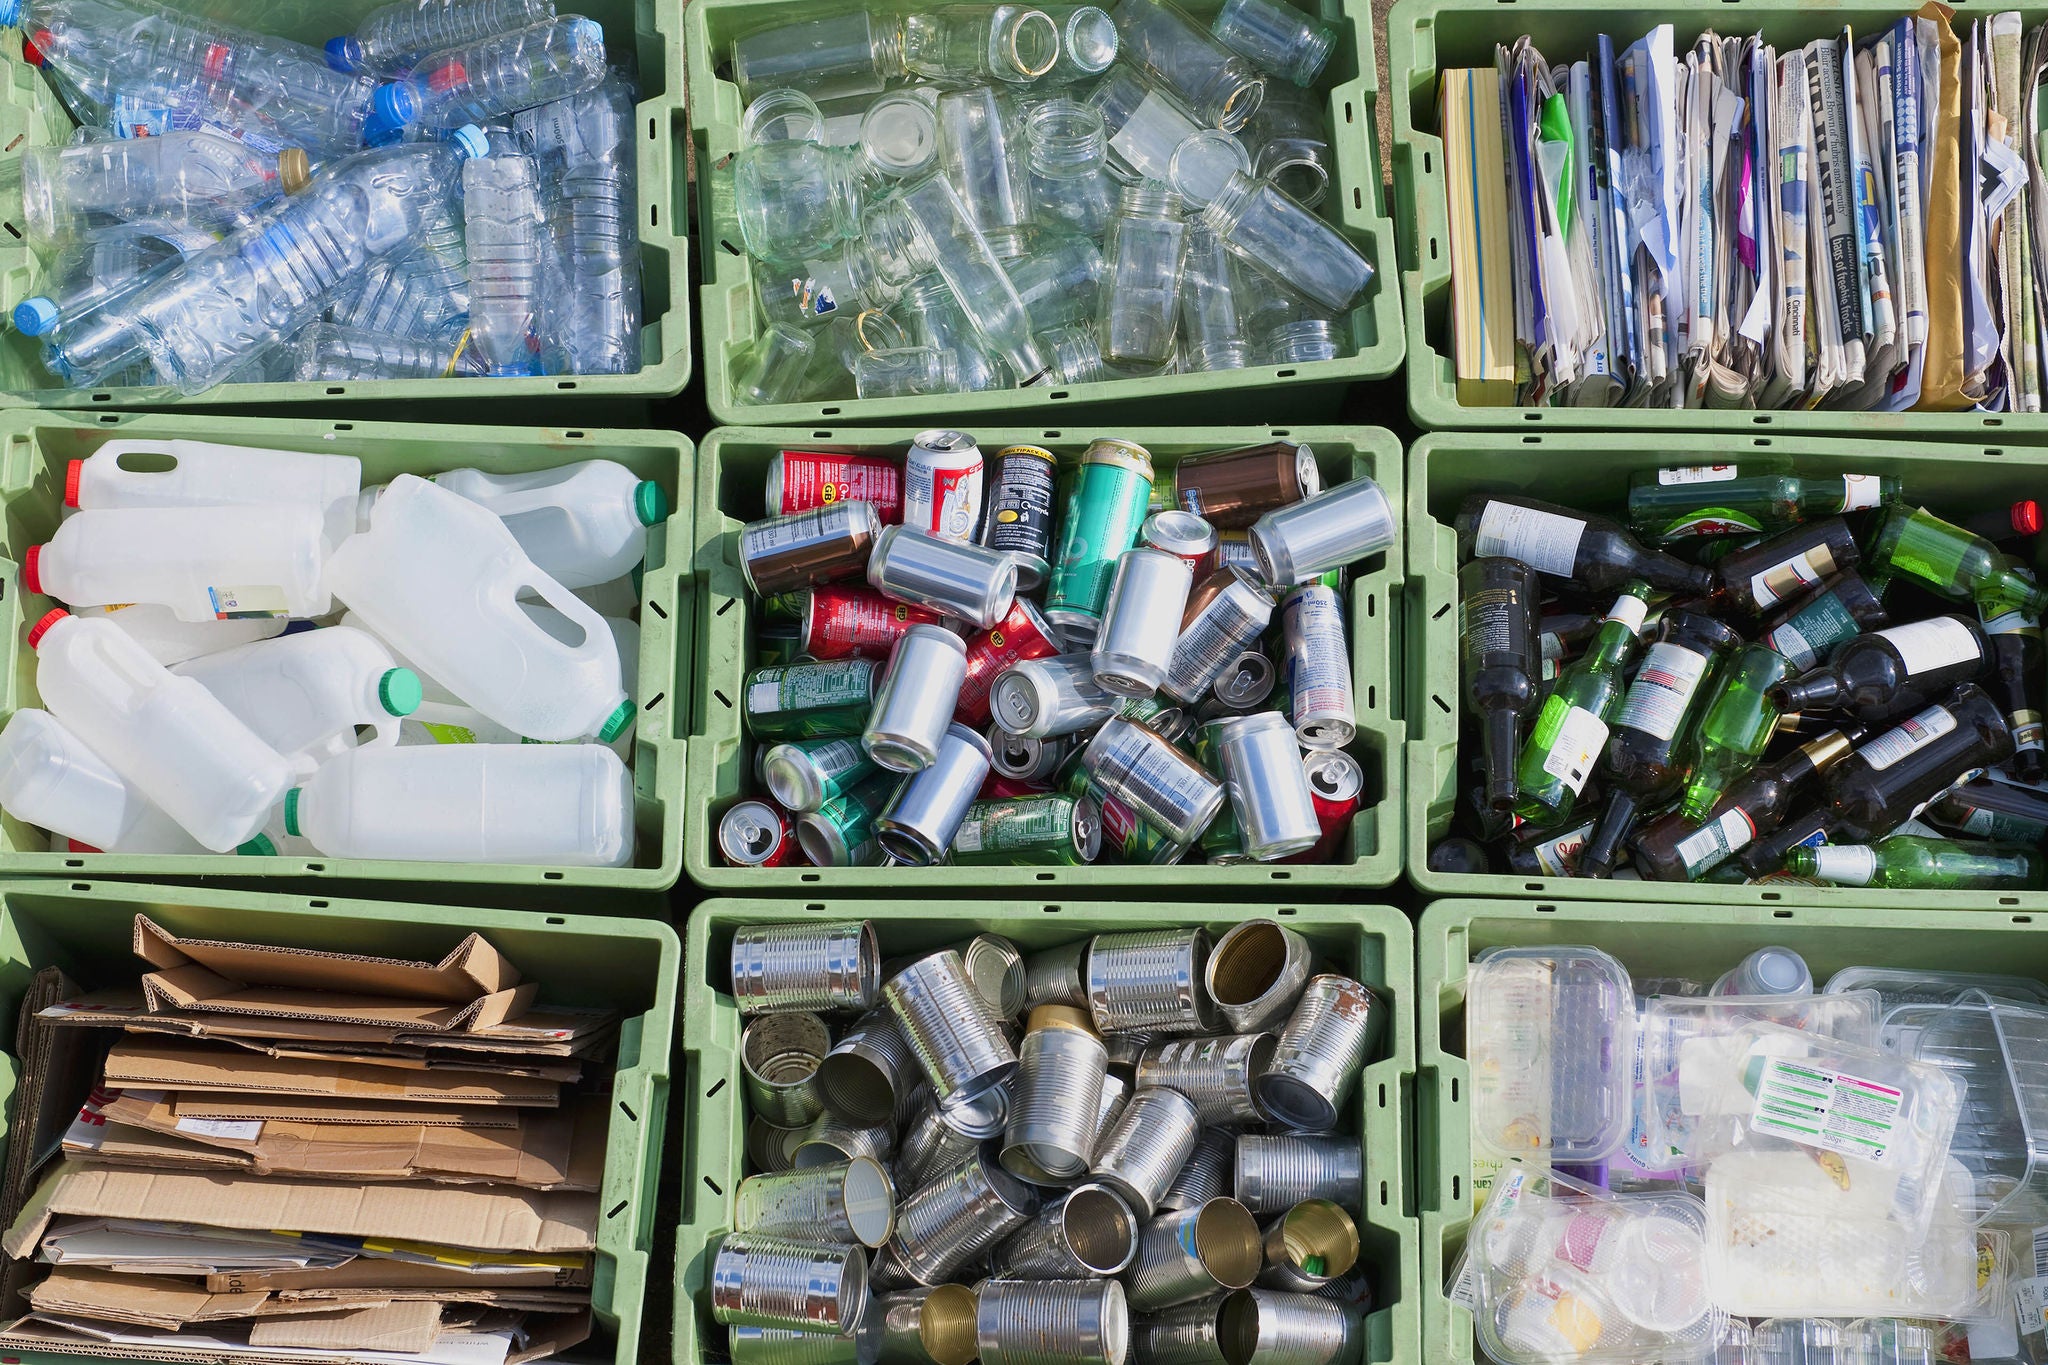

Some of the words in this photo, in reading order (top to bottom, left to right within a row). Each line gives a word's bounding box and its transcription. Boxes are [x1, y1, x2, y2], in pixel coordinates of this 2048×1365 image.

[1821, 47, 1830, 66] Blair
[1822, 68, 1834, 99] accuses
[1826, 101, 1837, 127] Brown
[1829, 129, 1838, 138] of
[1834, 168, 1843, 184] and
[1832, 238, 1845, 261] bags
[1836, 262, 1846, 272] of
[1792, 300, 1800, 335] Cincinnati
[1840, 306, 1852, 334] frocks
[1597, 361, 1603, 372] BT
[824, 484, 832, 500] GB
[897, 607, 906, 620] GB
[991, 632, 1003, 645] GB
